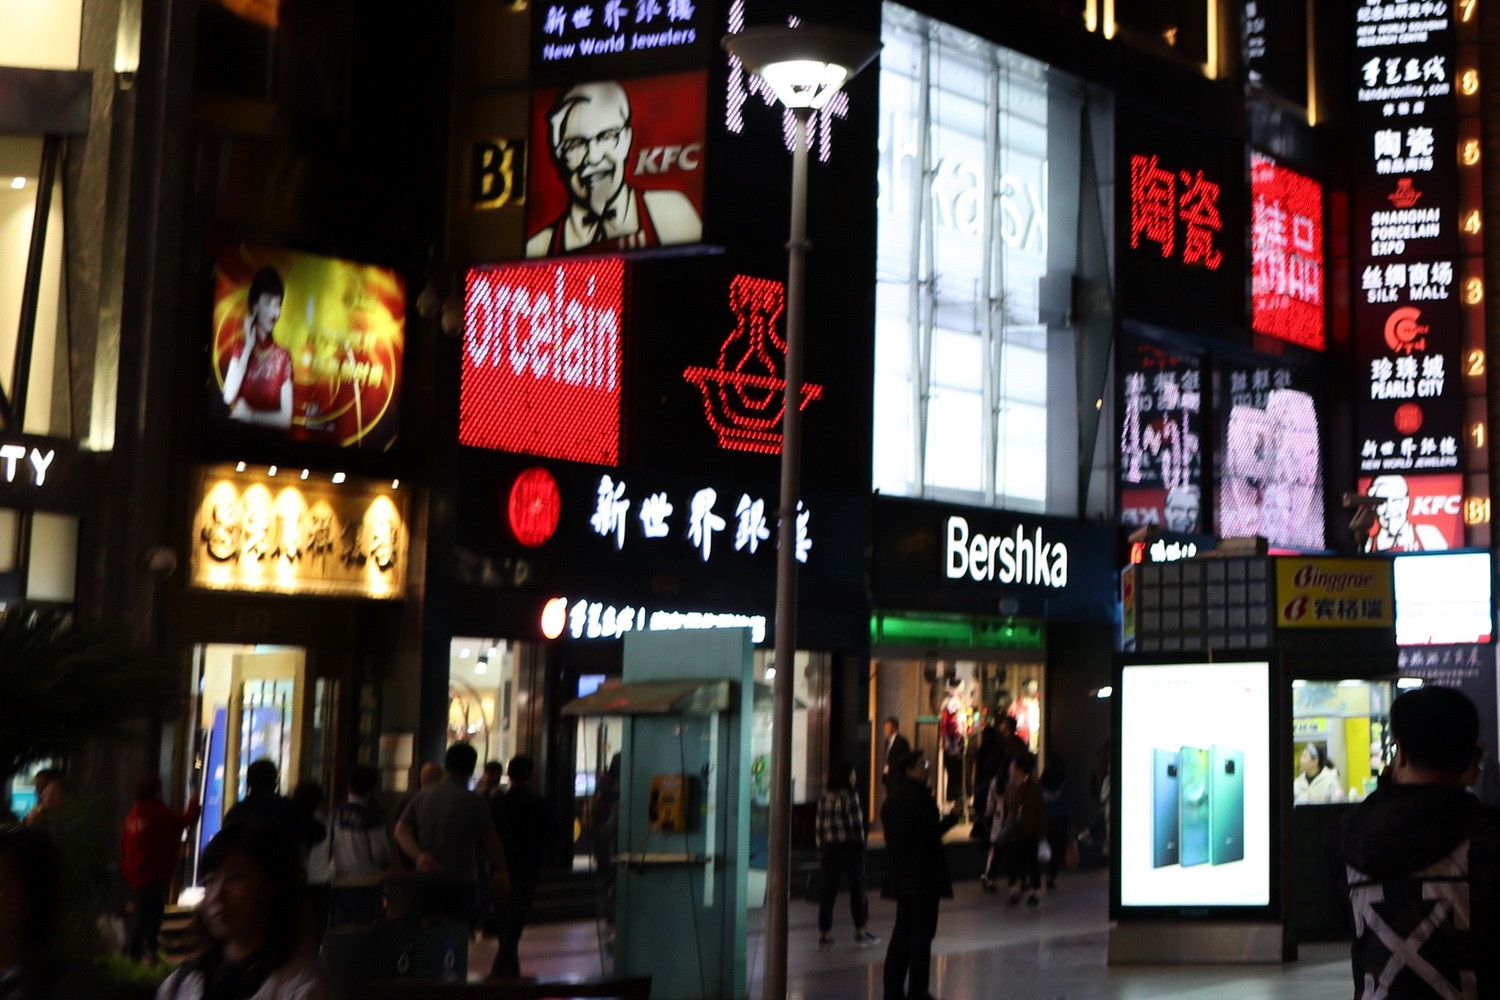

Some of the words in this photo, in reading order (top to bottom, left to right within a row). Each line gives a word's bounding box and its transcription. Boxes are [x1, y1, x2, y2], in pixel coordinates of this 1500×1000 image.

[542, 42, 576, 62] New
[580, 34, 625, 56] World
[630, 27, 696, 51] Jewelers
[633, 145, 700, 177] KFC
[1129, 153, 1224, 271] 陶瓷
[1371, 207, 1440, 227] SHANGHAI
[1465, 210, 1482, 235] 4
[1371, 222, 1440, 242] PORCELAIN
[1371, 239, 1405, 257] EXPO
[1367, 286, 1399, 303] SILK
[1410, 283, 1450, 301] MALL
[1466, 277, 1483, 304] 3
[1467, 350, 1484, 376] 2
[1371, 380, 1415, 400] PEARLS
[1417, 377, 1445, 398] CITY
[1471, 423, 1484, 449] 1
[1411, 495, 1461, 516] KFC
[946, 515, 1068, 588] Bershka
[1294, 564, 1374, 592] Binggrae
